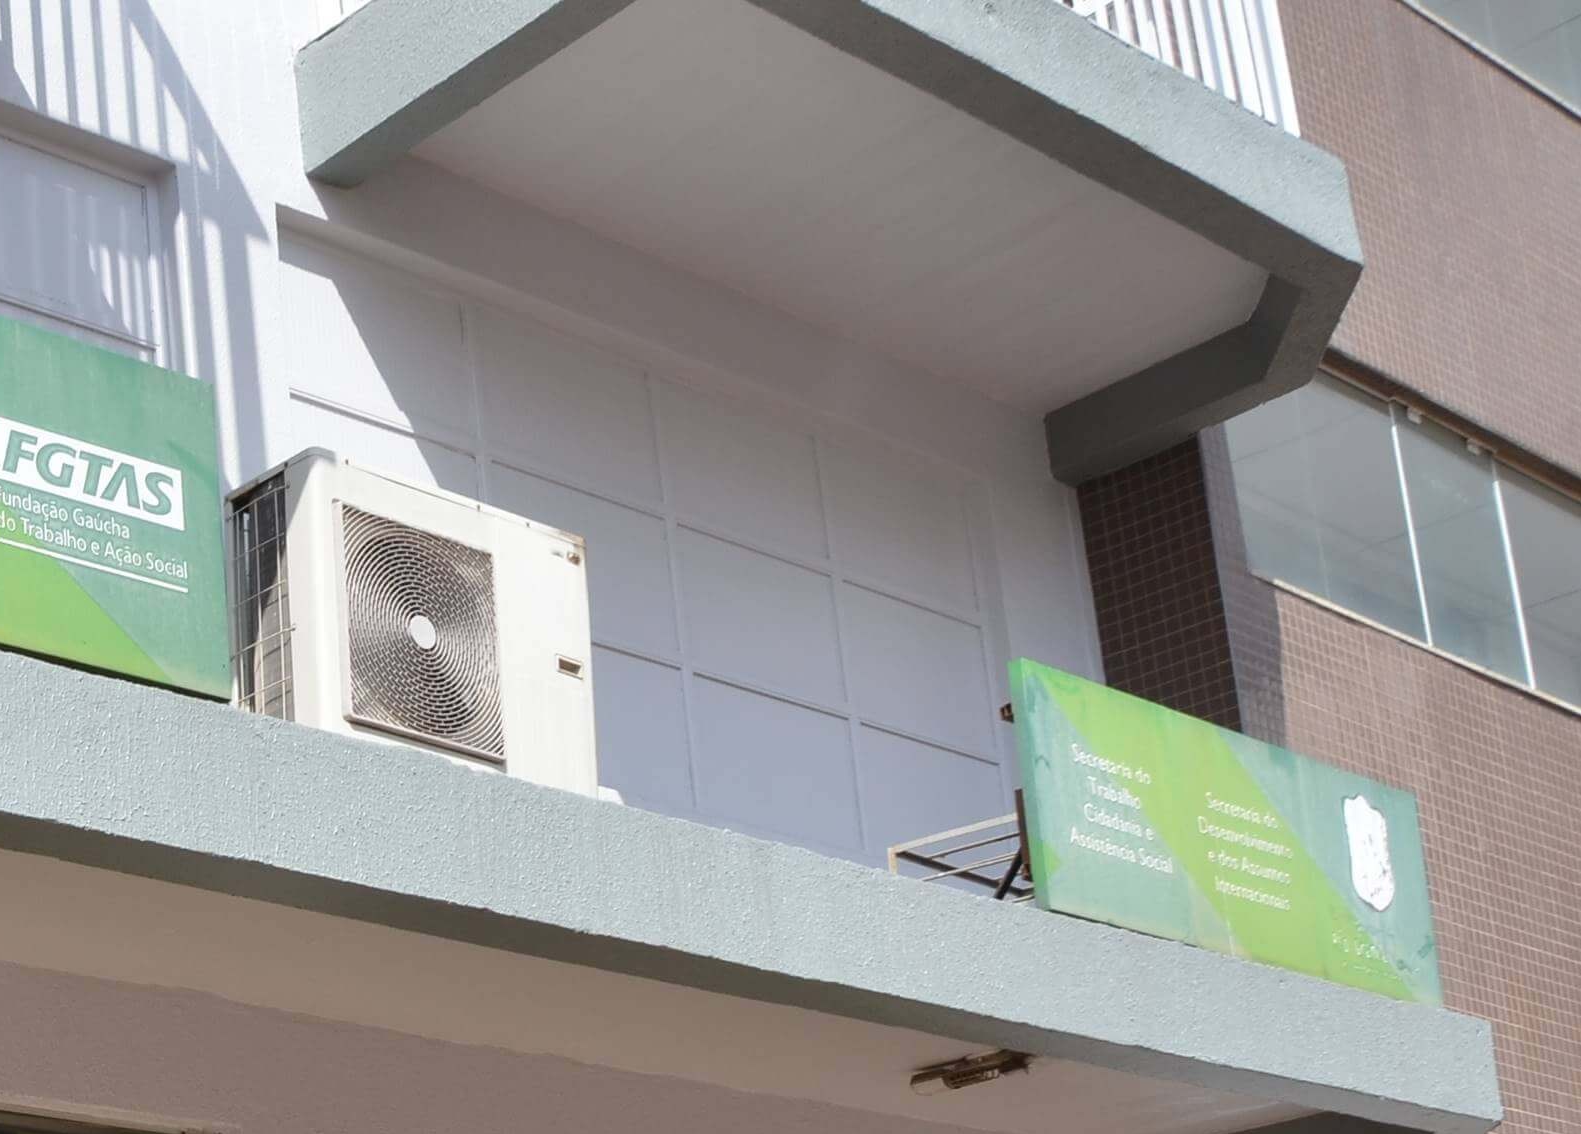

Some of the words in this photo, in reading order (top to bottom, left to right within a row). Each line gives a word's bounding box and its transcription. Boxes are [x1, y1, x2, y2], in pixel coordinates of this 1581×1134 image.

[2, 428, 175, 516] FGTAS
[72, 505, 131, 540] Gaúcha
[21, 518, 87, 553] Trabalho
[91, 541, 102, 555] e
[105, 541, 141, 570] Ação
[145, 551, 188, 580] Social
[1071, 743, 1132, 779] Secretaria
[1135, 767, 1151, 784] do
[1087, 775, 1141, 809] Trabalho
[1205, 791, 1261, 824] Secretaria
[1084, 803, 1142, 837] Cidadania
[1145, 828, 1154, 840] e
[1139, 847, 1173, 873] Social
[1208, 851, 1215, 862] e
